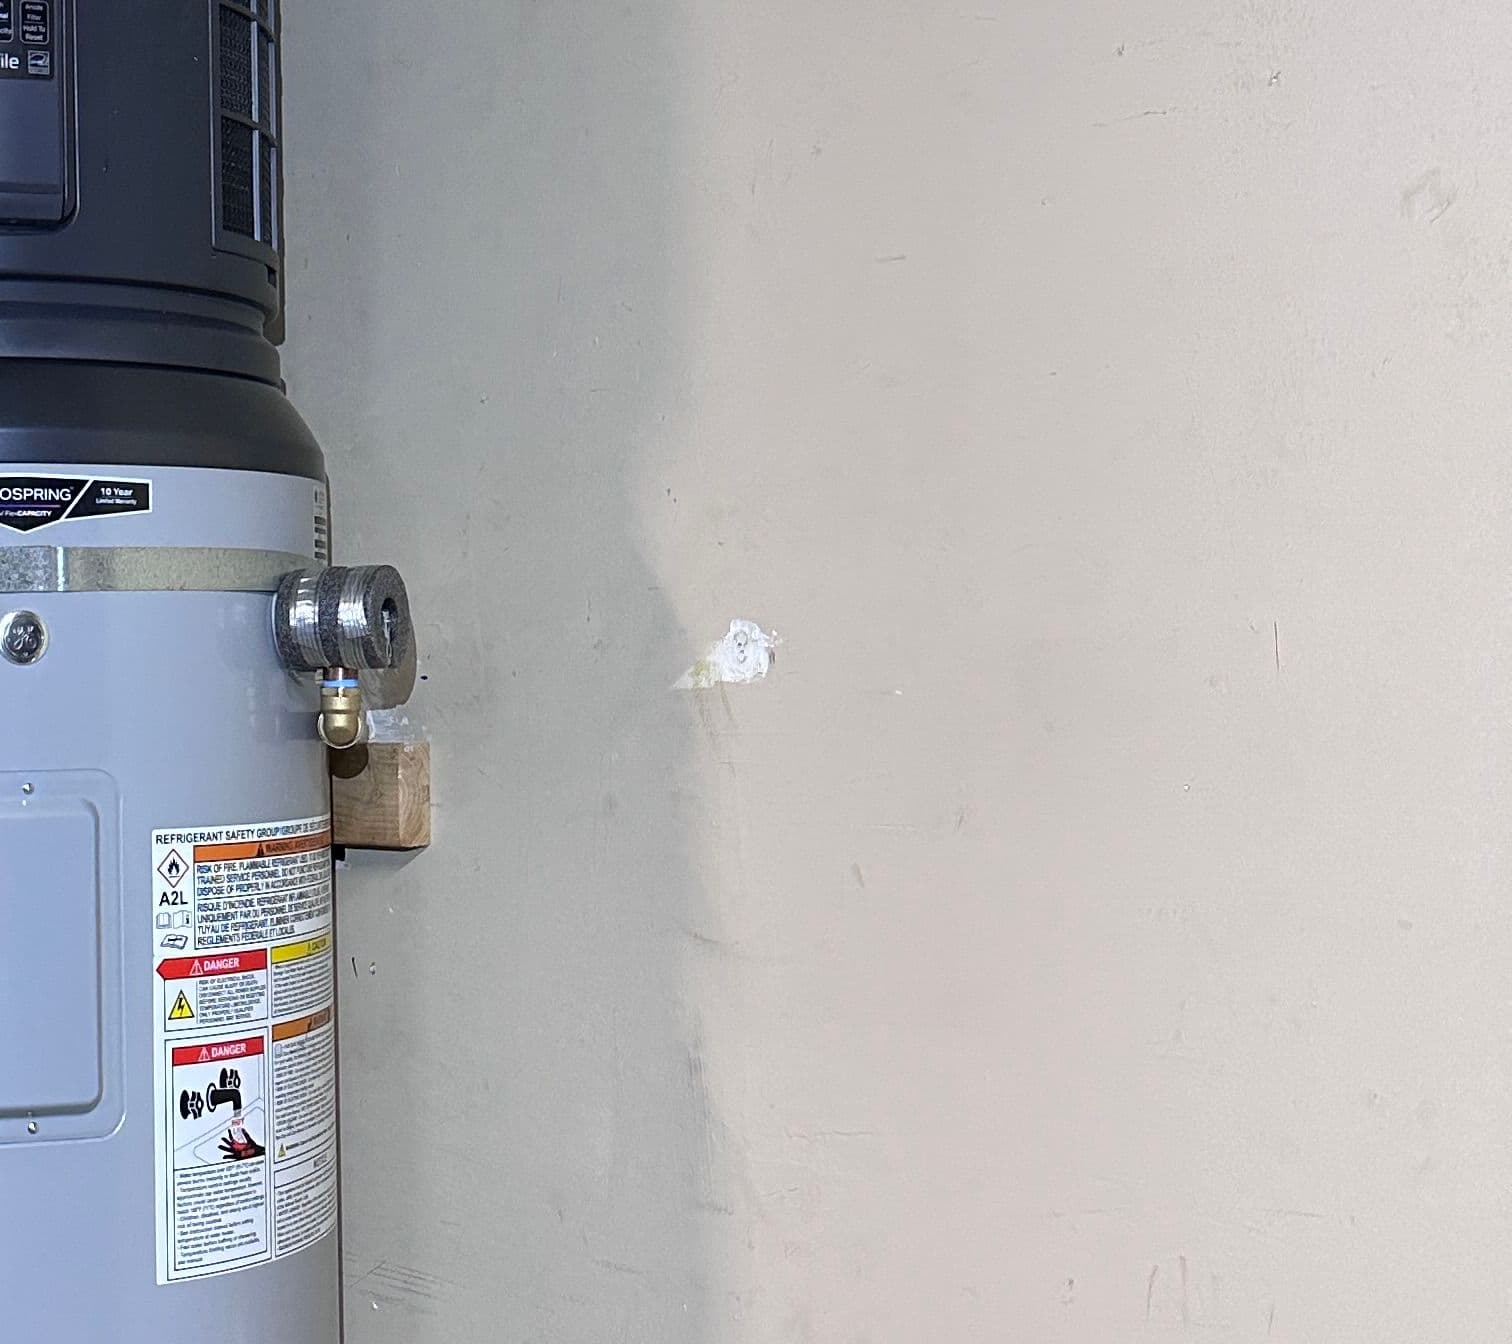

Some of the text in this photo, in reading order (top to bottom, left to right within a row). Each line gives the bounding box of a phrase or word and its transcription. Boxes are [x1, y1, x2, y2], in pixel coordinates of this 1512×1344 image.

[100, 487, 134, 497] 10 Year
[155, 830, 224, 845] REFRIGERANT
[225, 828, 256, 841] SAFETY
[159, 890, 189, 907] A2L
[203, 957, 240, 972] DANGER
[211, 1042, 247, 1059] DANGER
